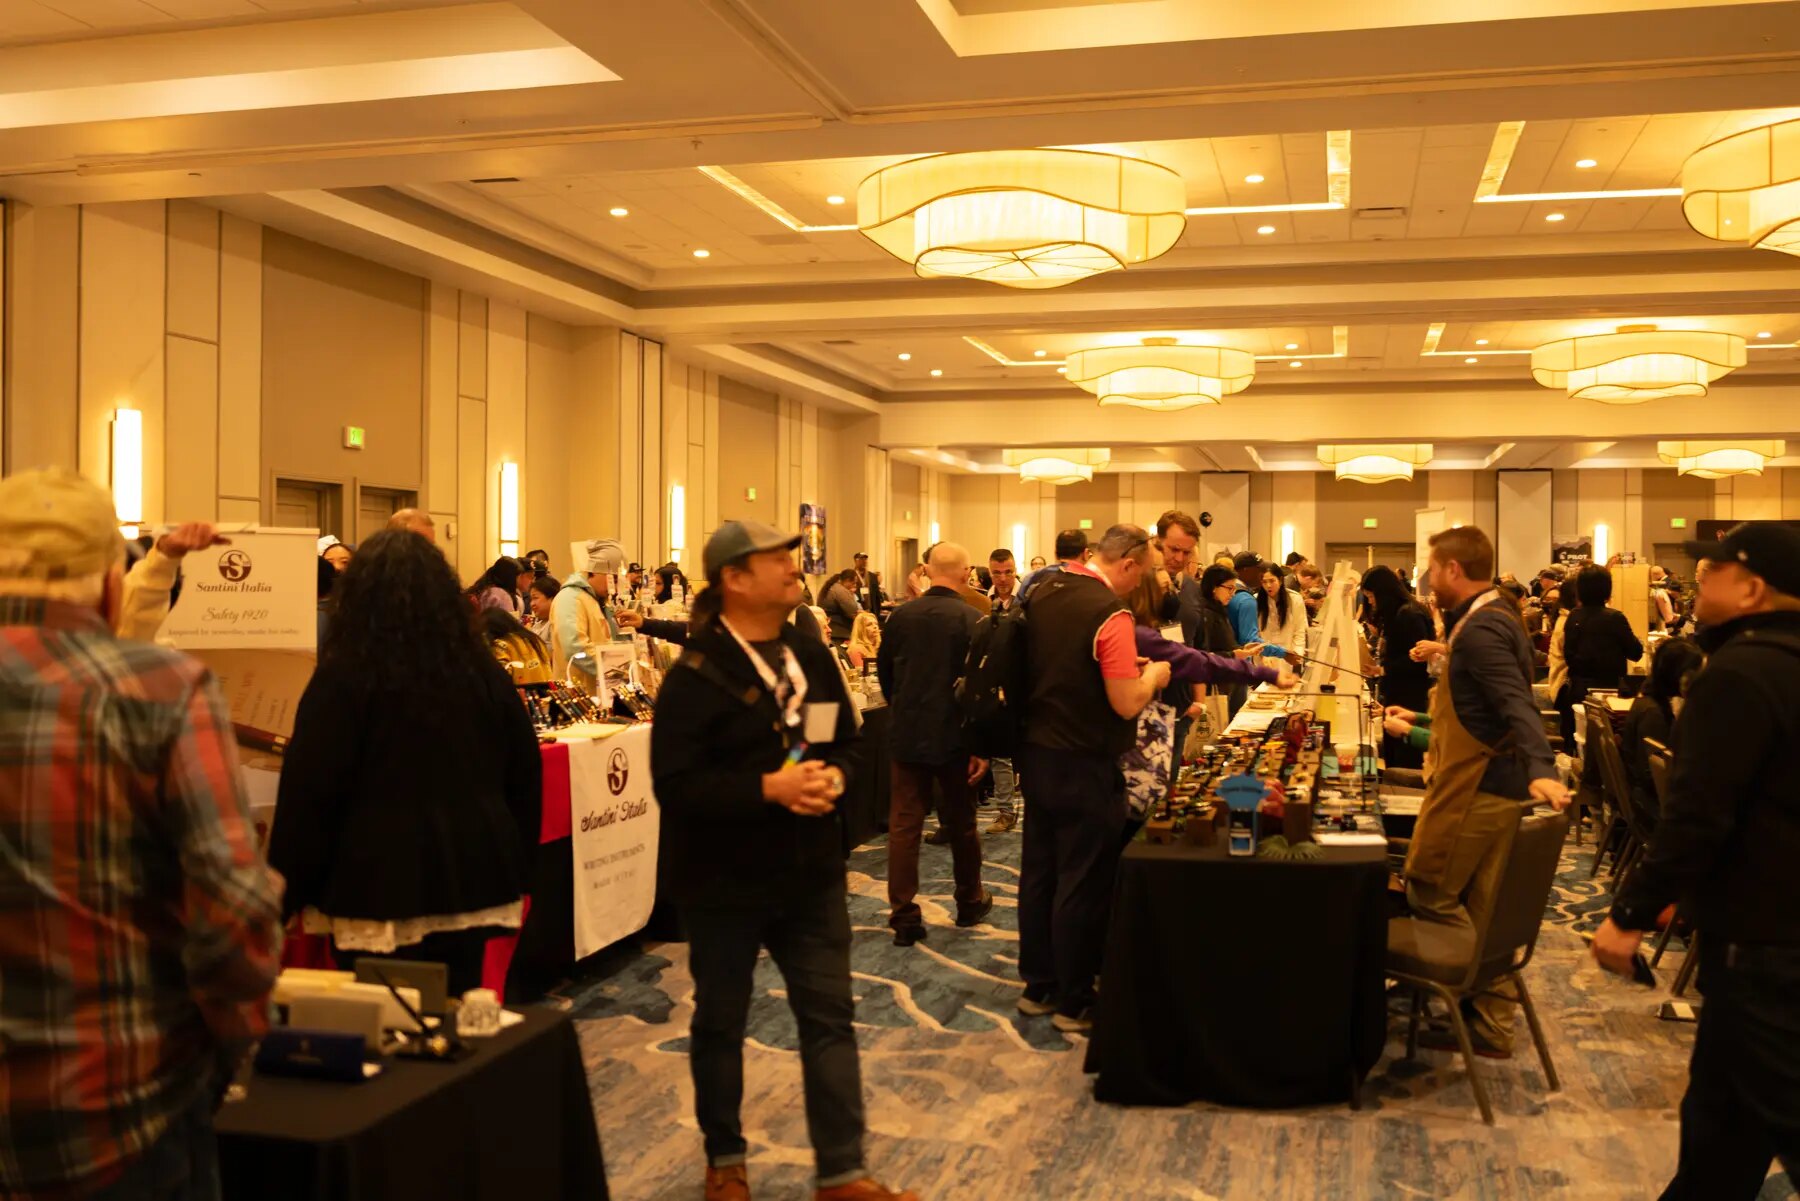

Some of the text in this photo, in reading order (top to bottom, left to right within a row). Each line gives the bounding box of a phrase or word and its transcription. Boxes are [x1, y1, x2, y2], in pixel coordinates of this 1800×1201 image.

[196, 581, 272, 593] Santini Italia
[202, 606, 239, 625] Safety
